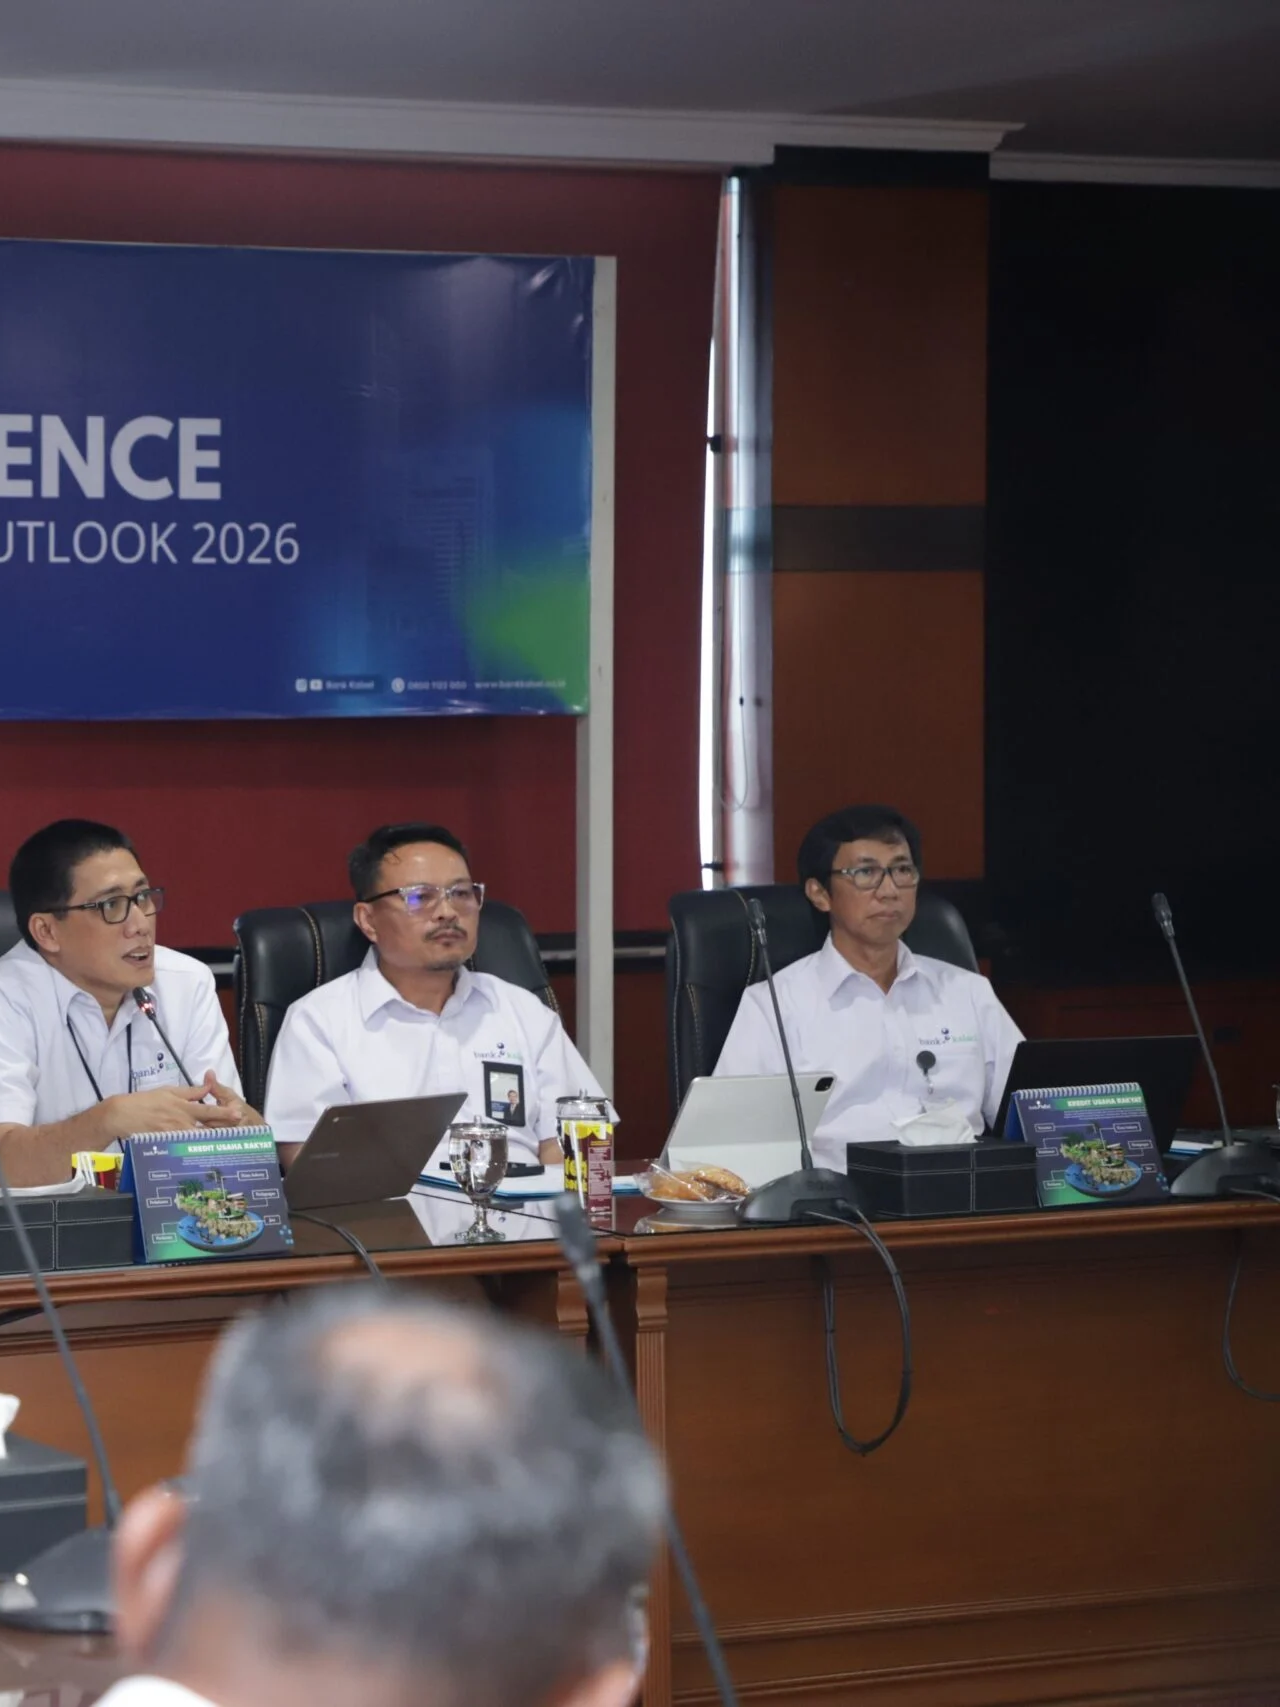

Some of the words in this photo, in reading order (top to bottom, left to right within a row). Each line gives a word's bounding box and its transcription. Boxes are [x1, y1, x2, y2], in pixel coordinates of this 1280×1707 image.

[192, 522, 300, 565] 2026
[188, 1144, 214, 1153] KREDIT
[216, 1143, 243, 1151] USAHA
[244, 1141, 272, 1150] RAKYAT
